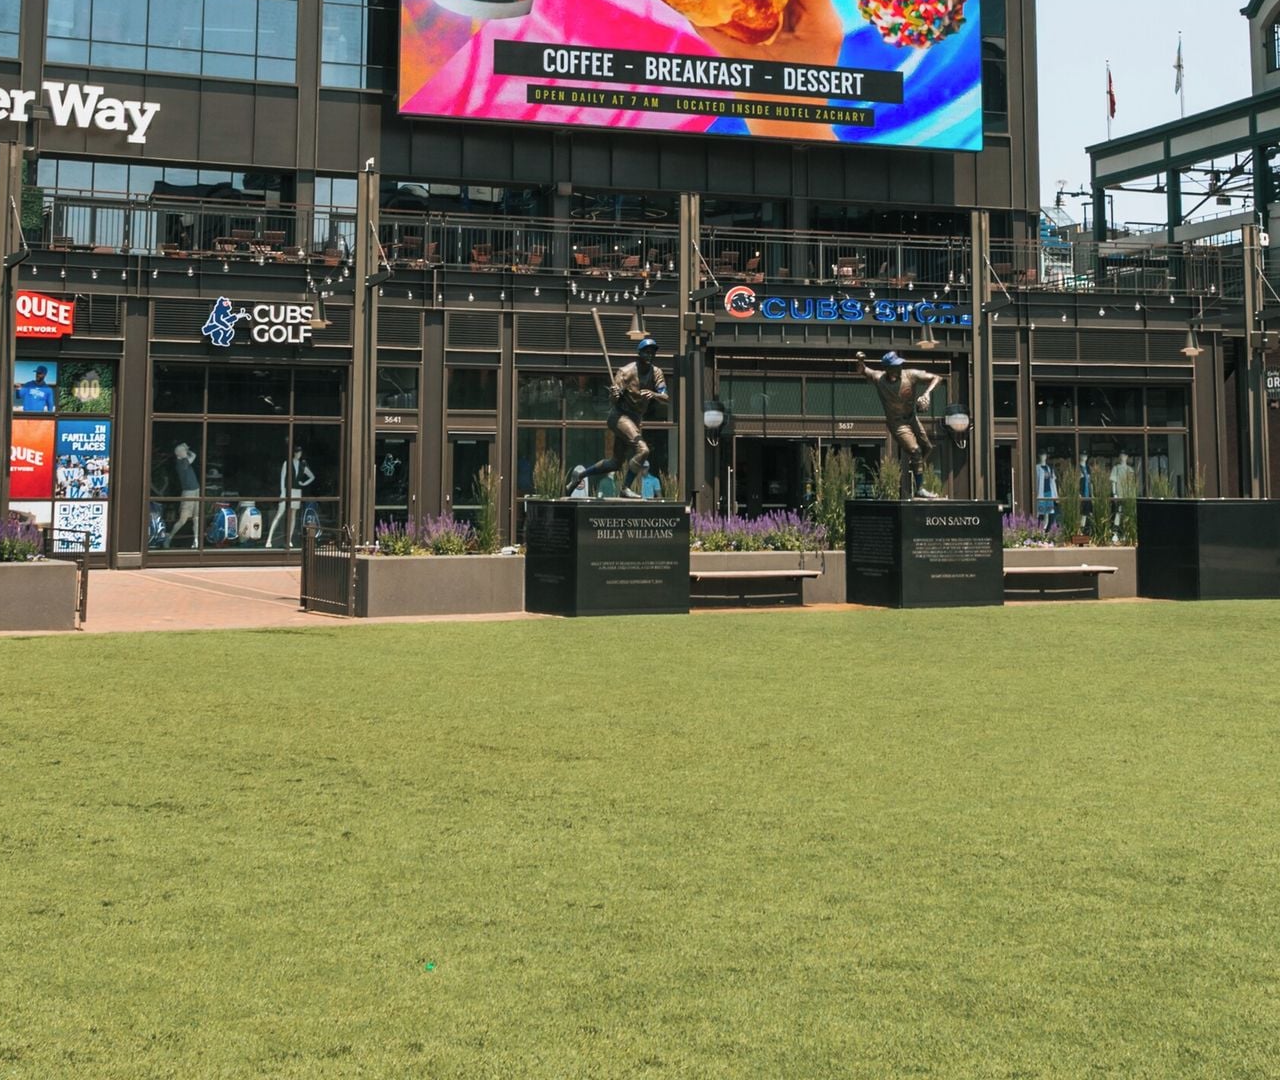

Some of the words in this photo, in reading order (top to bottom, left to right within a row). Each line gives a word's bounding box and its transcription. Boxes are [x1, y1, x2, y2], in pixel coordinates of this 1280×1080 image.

[542, 48, 615, 78] COFFEE
[645, 56, 754, 88] BREAKFAST
[783, 67, 865, 96] DESSERT
[535, 89, 566, 102] OPEN
[571, 91, 606, 104] DAILY
[612, 94, 625, 106] AT
[631, 96, 638, 107] 7
[643, 97, 660, 108] AM
[676, 99, 726, 113] LOCATED
[731, 103, 770, 115] INSIDE
[776, 106, 810, 119] HOTEL
[815, 109, 866, 122] ZACHARY
[41, 81, 161, 144] Way
[252, 304, 314, 324] CUBS
[761, 297, 865, 321] CUBS
[16, 324, 57, 333] NETWORK
[252, 325, 312, 344] GOLF
[384, 416, 402, 424] 3641
[94, 424, 107, 434] IN
[61, 433, 107, 442] FAMILIAR
[72, 442, 107, 452] PLACES
[589, 517, 681, 528] "SWEET-SWINGING"
[925, 516, 947, 526] RON
[948, 516, 980, 526] SANTO
[597, 529, 625, 539] BILLY
[626, 529, 674, 539] WILLIAMS
